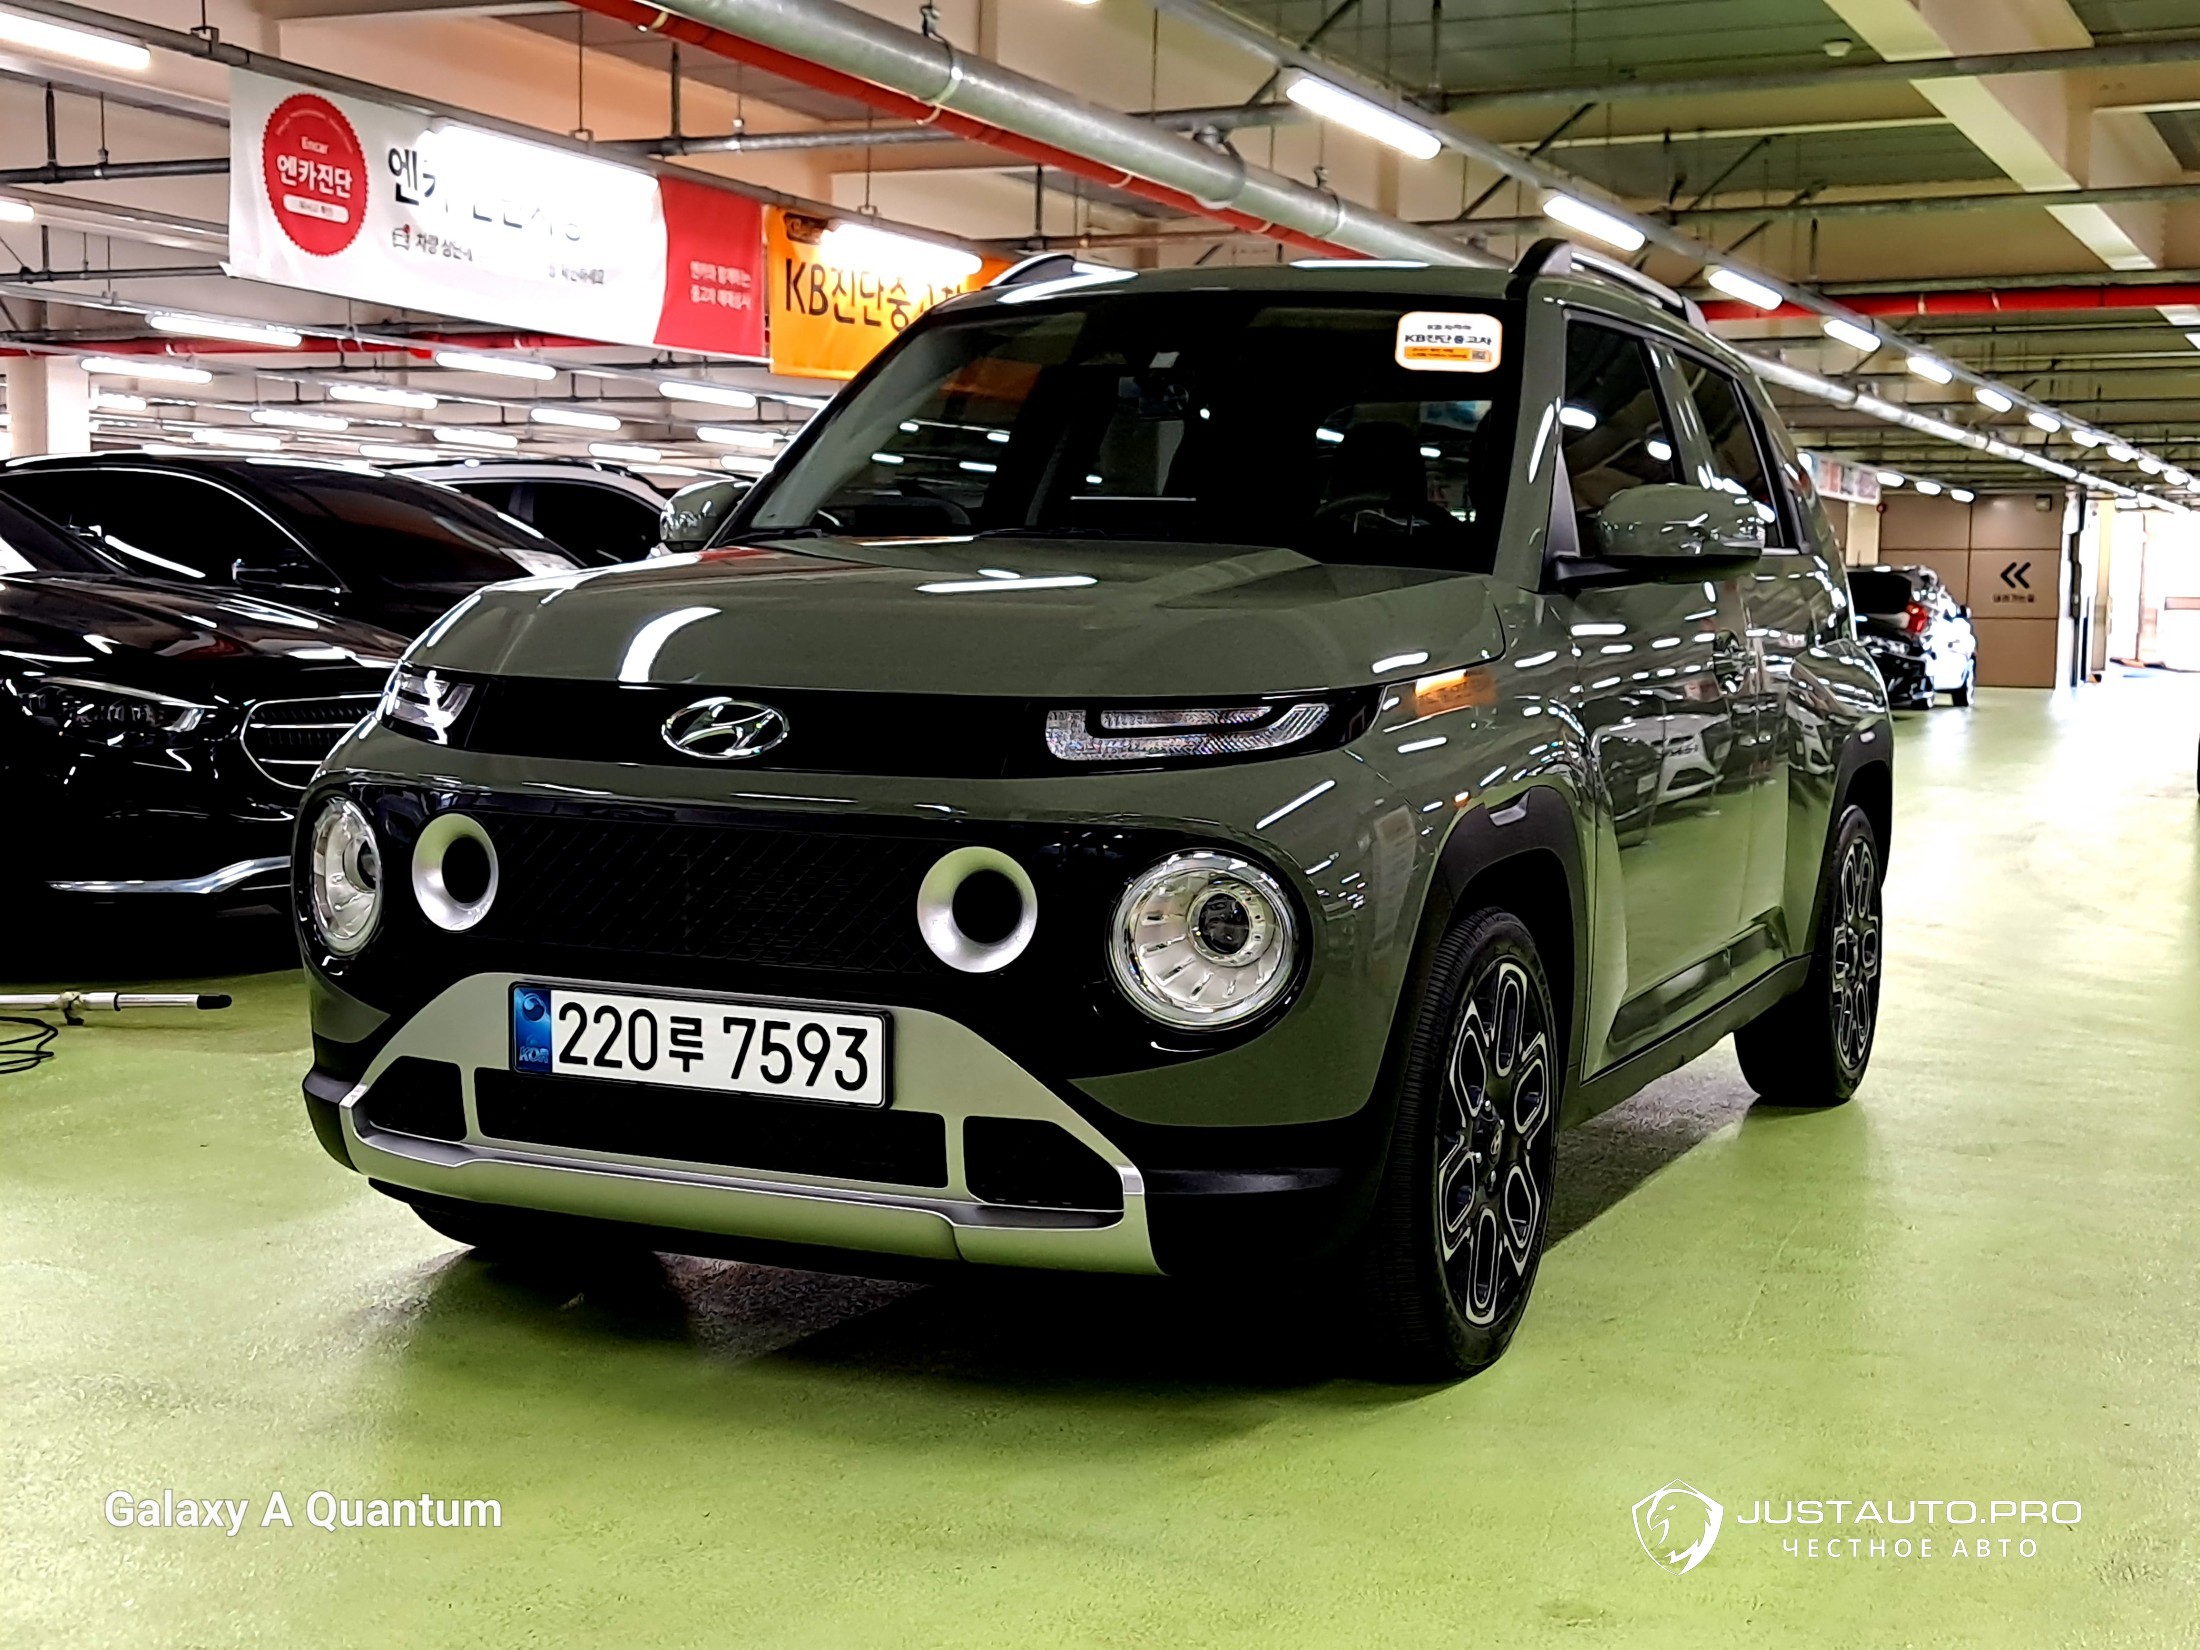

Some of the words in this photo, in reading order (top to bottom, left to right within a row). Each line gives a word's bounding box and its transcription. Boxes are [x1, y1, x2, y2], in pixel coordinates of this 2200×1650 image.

[276, 154, 353, 199] 엔카진단
[518, 1046, 550, 1064] KOR
[559, 1002, 704, 1073] 220루
[723, 1016, 868, 1091] 7593
